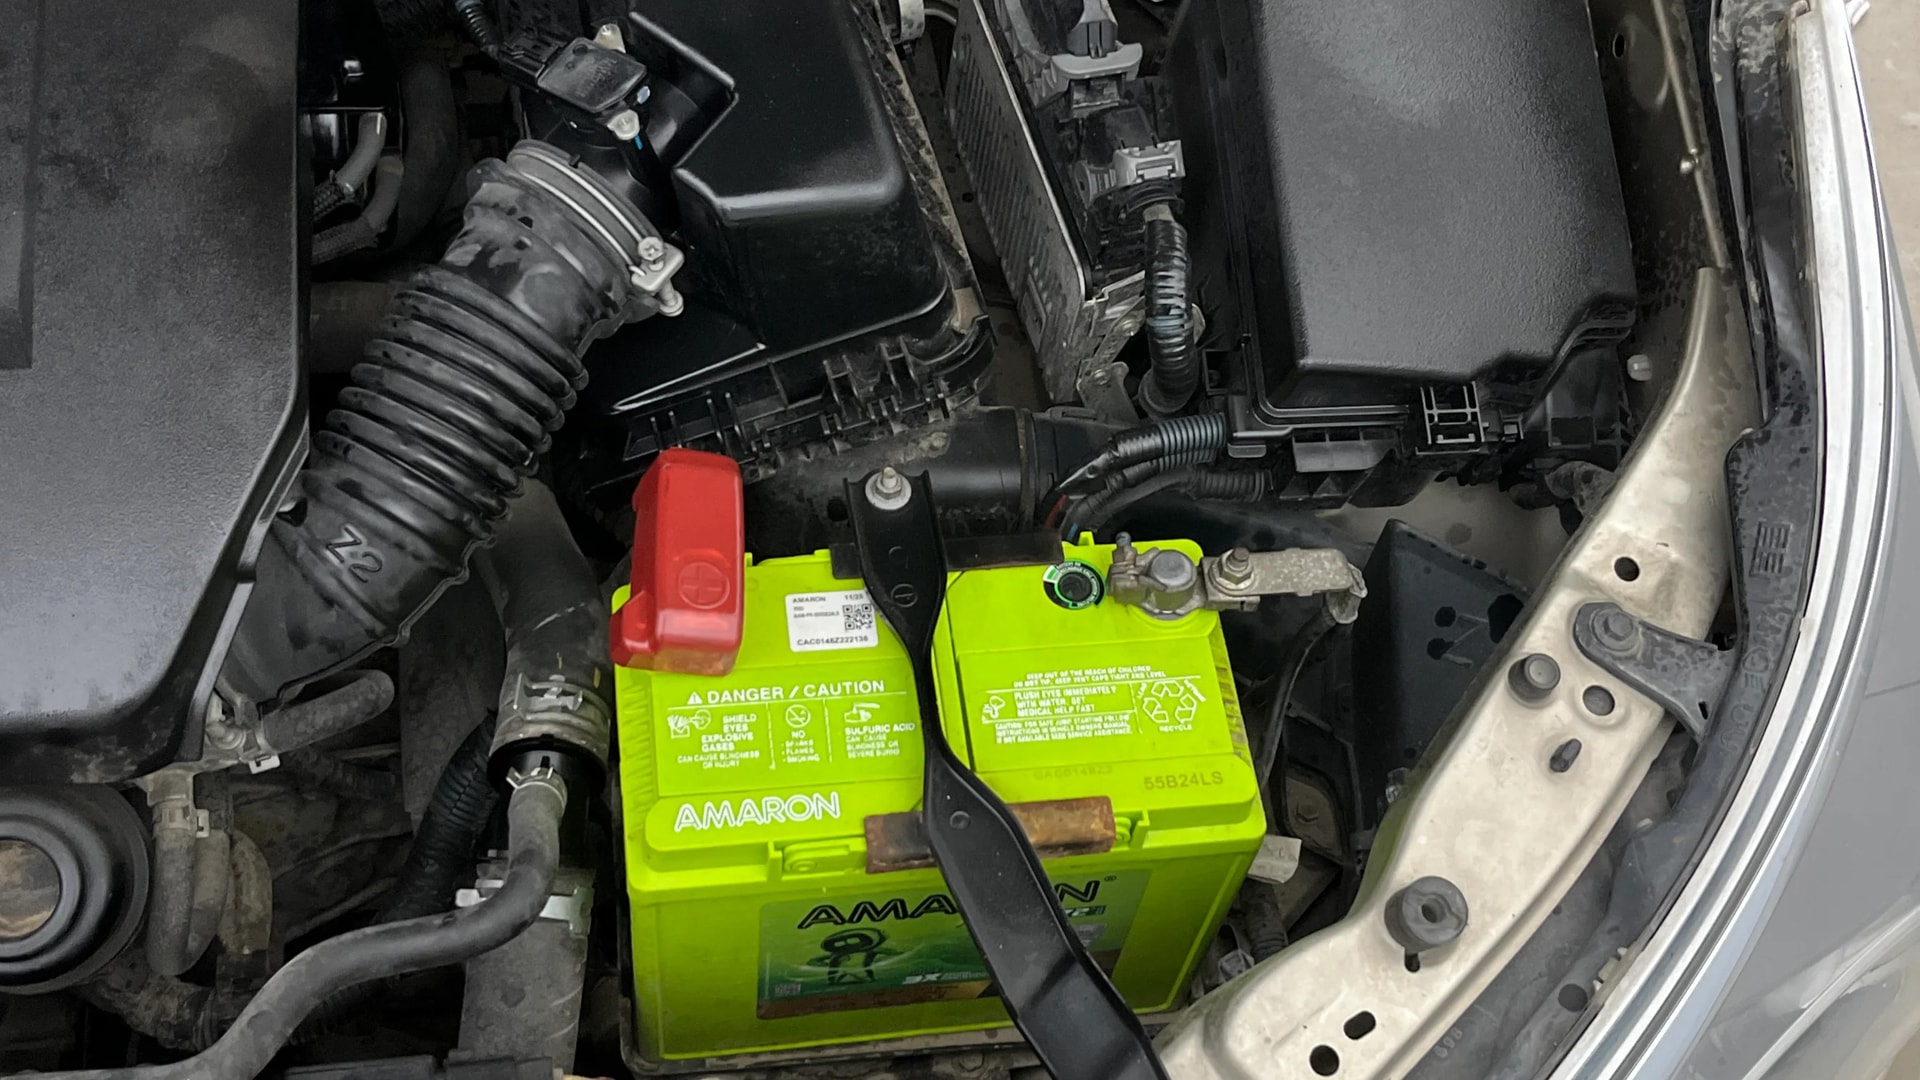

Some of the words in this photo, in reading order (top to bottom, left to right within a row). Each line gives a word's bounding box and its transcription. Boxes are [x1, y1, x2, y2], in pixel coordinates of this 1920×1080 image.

[793, 596, 826, 604] AMARON
[1027, 672, 1043, 680] KEEP
[1045, 671, 1058, 679] OUT
[1070, 669, 1083, 677] THE
[1092, 674, 1109, 682] CAPS
[1110, 673, 1130, 681] TIGHT
[1147, 670, 1167, 678] LEVEL
[707, 687, 784, 704] DANGER
[789, 686, 799, 699] /
[803, 680, 885, 697] CAUTION
[1014, 690, 1040, 700] FLUSH
[1042, 688, 1061, 698] EYES
[1063, 685, 1117, 696] IMMEDIATELY
[1016, 700, 1037, 709] WITH
[1071, 696, 1086, 705] GET
[1017, 707, 1052, 717] MEDICAL
[1055, 704, 1074, 714] HELP
[1076, 703, 1095, 712] FAST
[722, 713, 757, 724] SHIELD
[723, 723, 749, 733] EYES
[845, 724, 890, 735] SULFURIC
[893, 722, 916, 732] ACID
[1159, 724, 1192, 732] RECYCLE
[701, 732, 754, 744] EXPLOSIVE
[791, 730, 806, 739] NO
[702, 742, 735, 752] GASES
[1143, 771, 1224, 791] 55B24LS
[674, 791, 840, 832] AMARON
